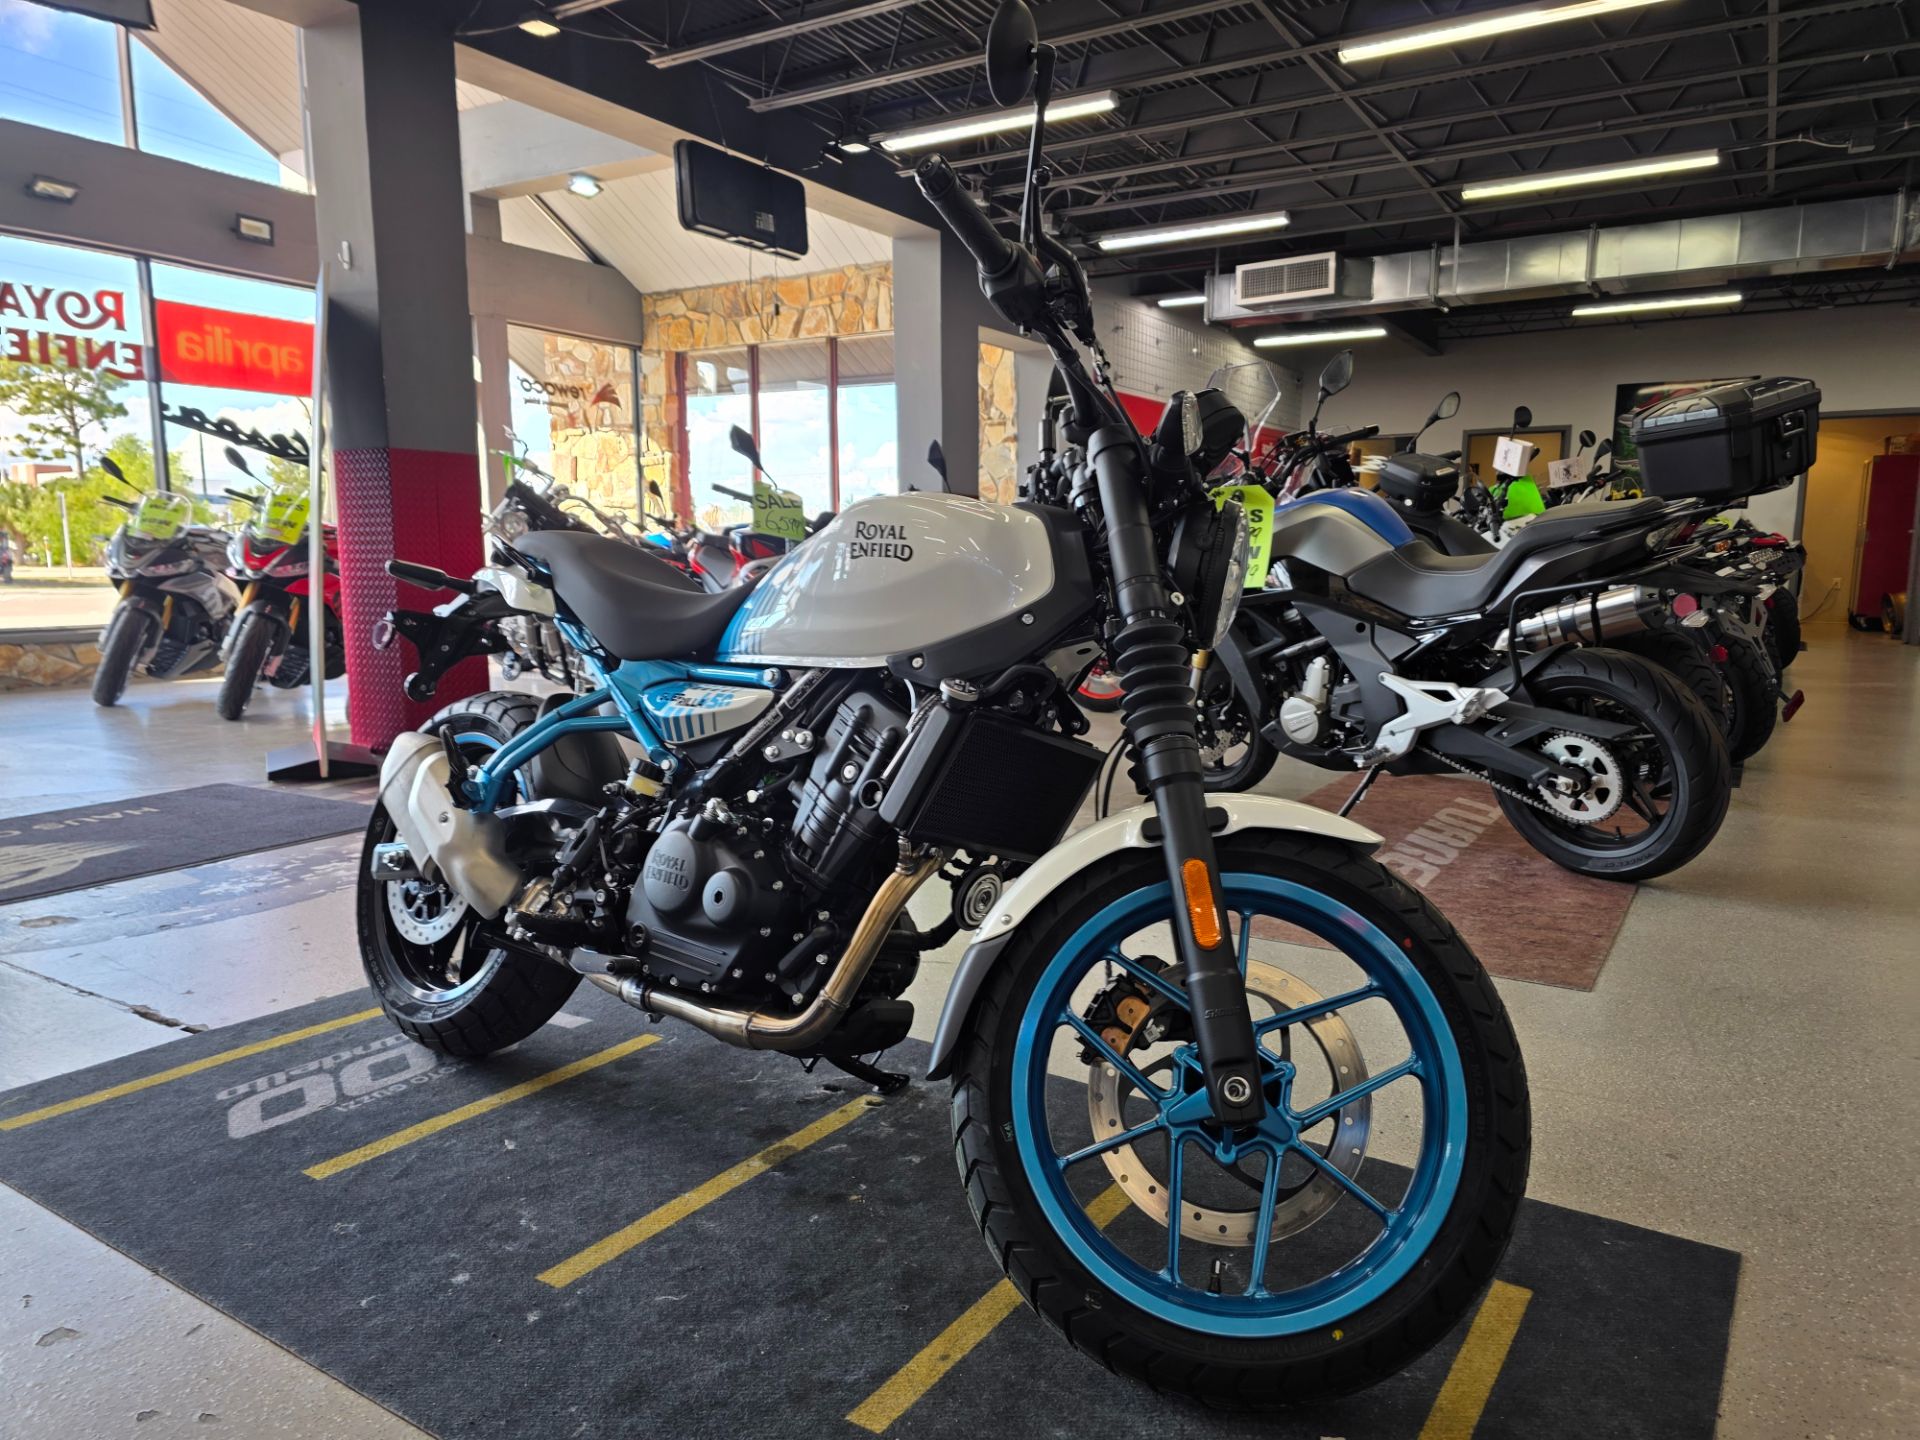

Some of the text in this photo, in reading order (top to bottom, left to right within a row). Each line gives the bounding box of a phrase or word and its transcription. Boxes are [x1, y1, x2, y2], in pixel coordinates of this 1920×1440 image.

[754, 493, 802, 510] SALE
[855, 520, 907, 540] ROYAL
[850, 542, 913, 562] ENFIELD
[651, 848, 686, 872] ROYAL
[645, 866, 690, 891] ENFIELD
[334, 1062, 466, 1112] OTO GUZZI
